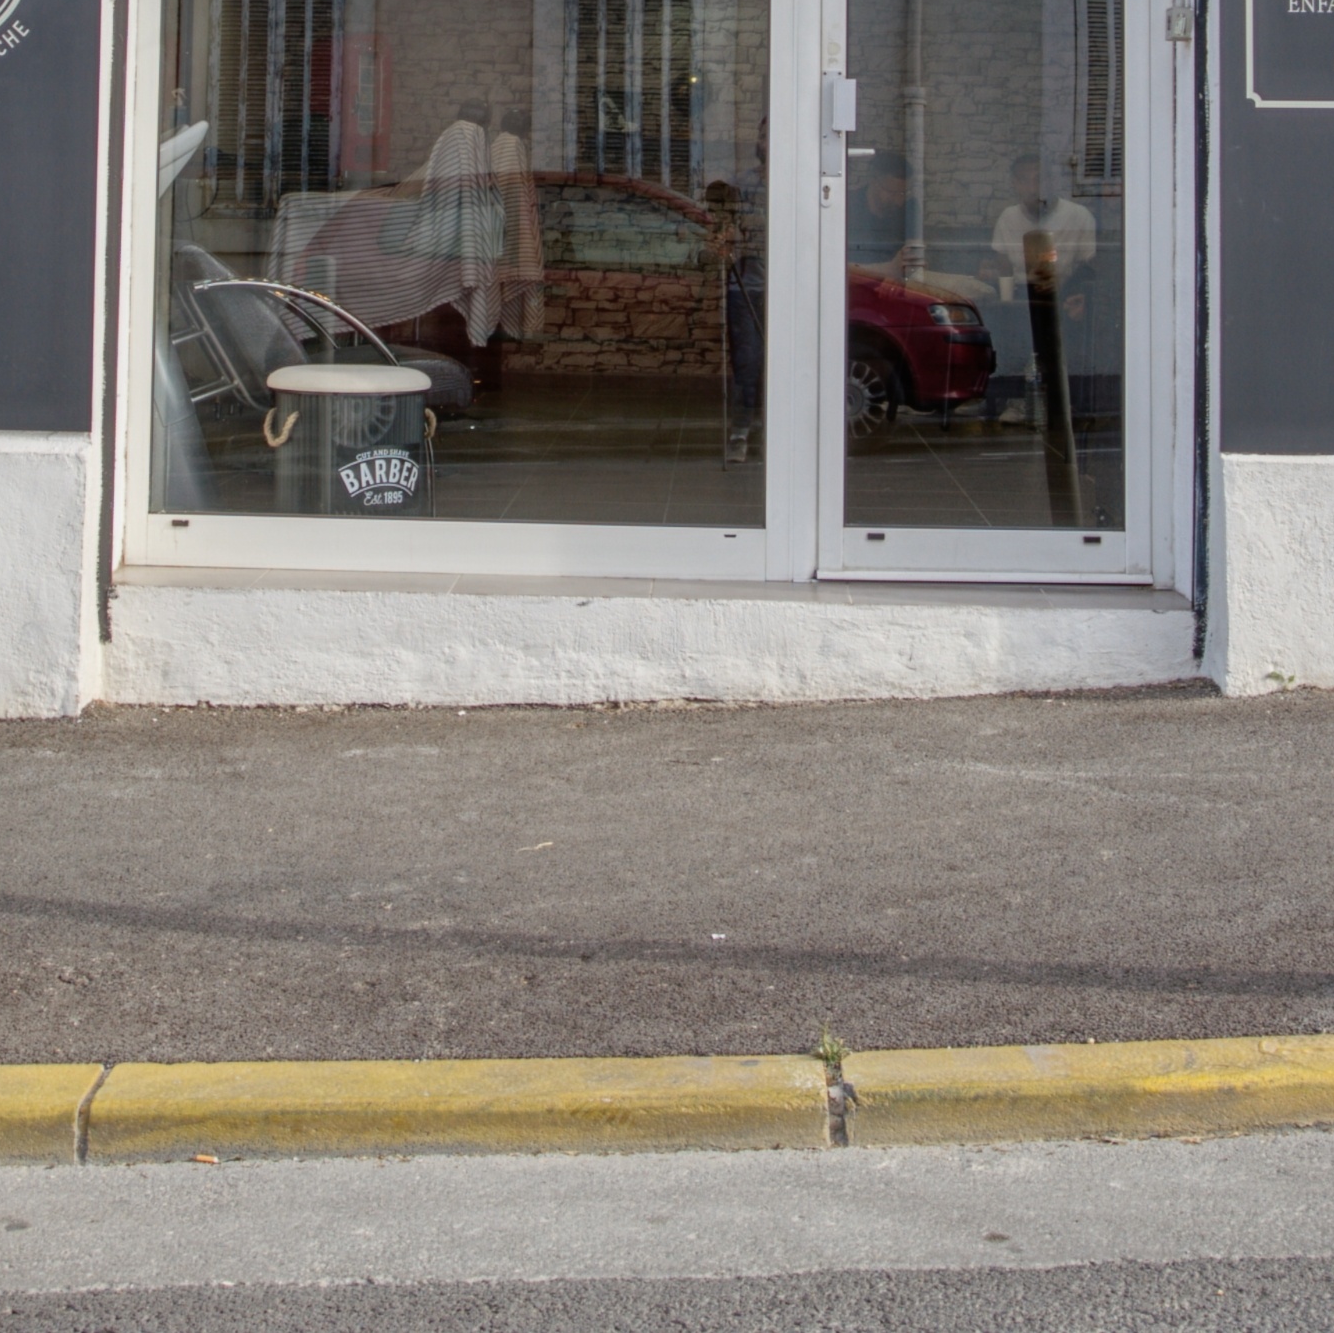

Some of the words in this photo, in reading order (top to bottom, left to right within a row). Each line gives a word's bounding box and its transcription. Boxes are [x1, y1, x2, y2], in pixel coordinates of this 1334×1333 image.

[356, 451, 371, 461] CUT
[373, 449, 389, 457] AND
[340, 459, 419, 494] BARBER
[384, 491, 403, 504] 1895
